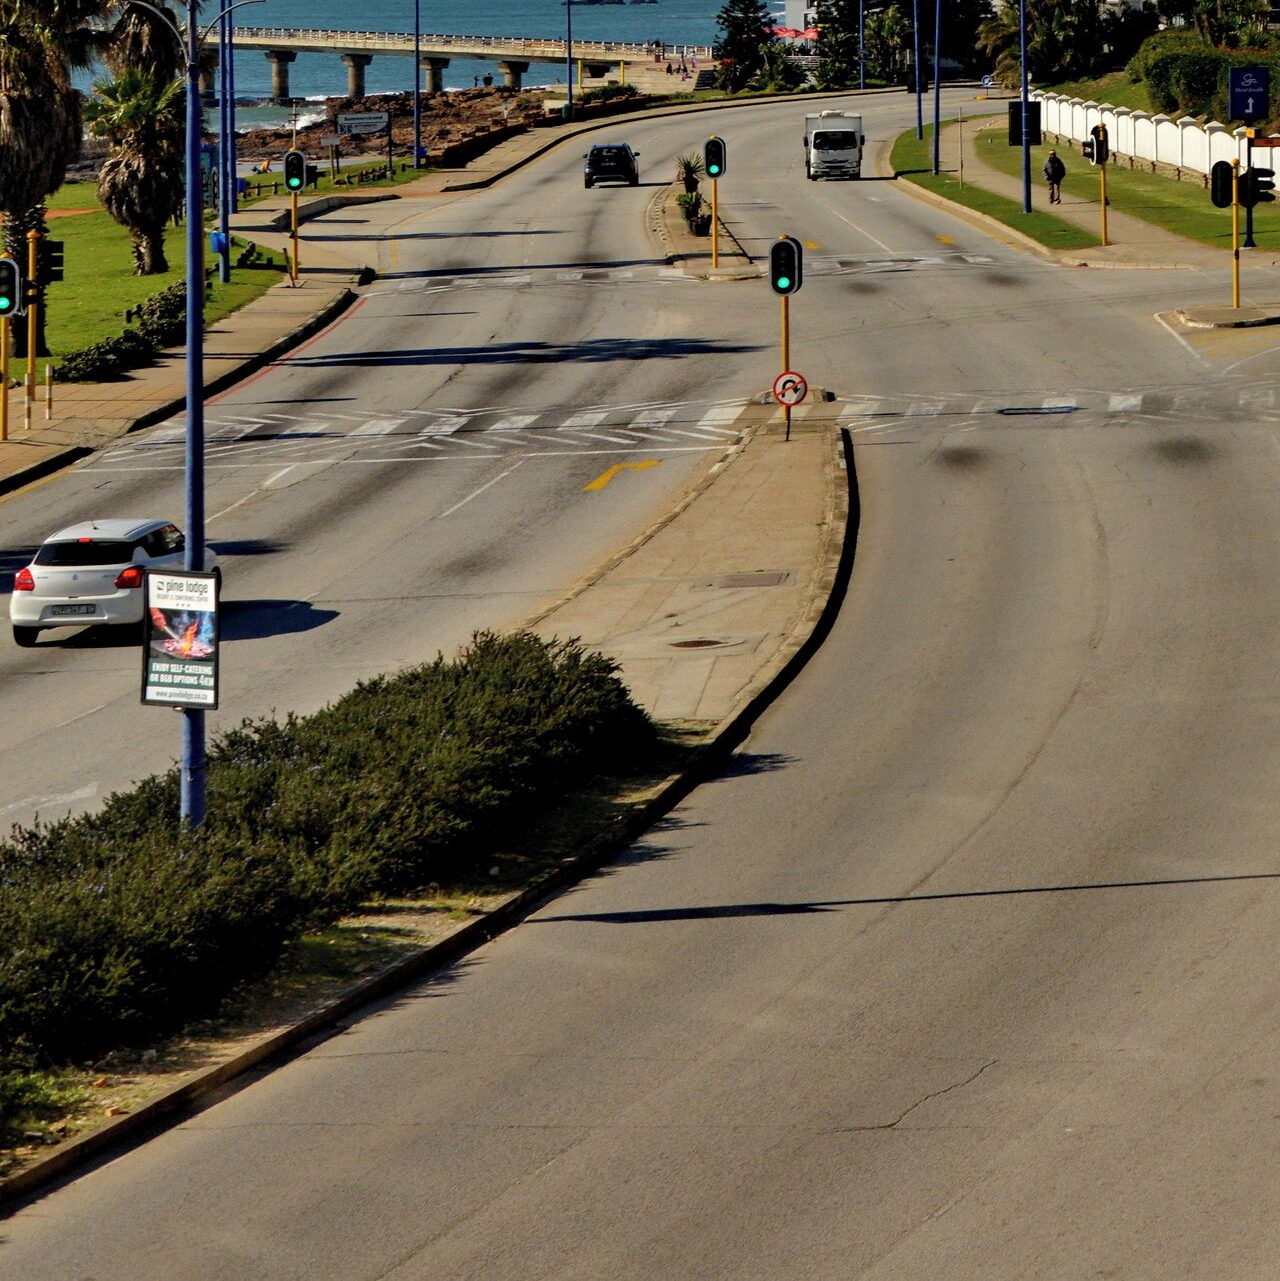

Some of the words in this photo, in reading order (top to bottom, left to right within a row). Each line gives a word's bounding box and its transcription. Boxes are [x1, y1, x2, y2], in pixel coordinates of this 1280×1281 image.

[166, 579, 184, 593] pine
[186, 580, 209, 596] lodge
[152, 662, 170, 672] ENJOY
[170, 663, 212, 675] SELF-CATERING
[173, 674, 198, 685] OPTIONS
